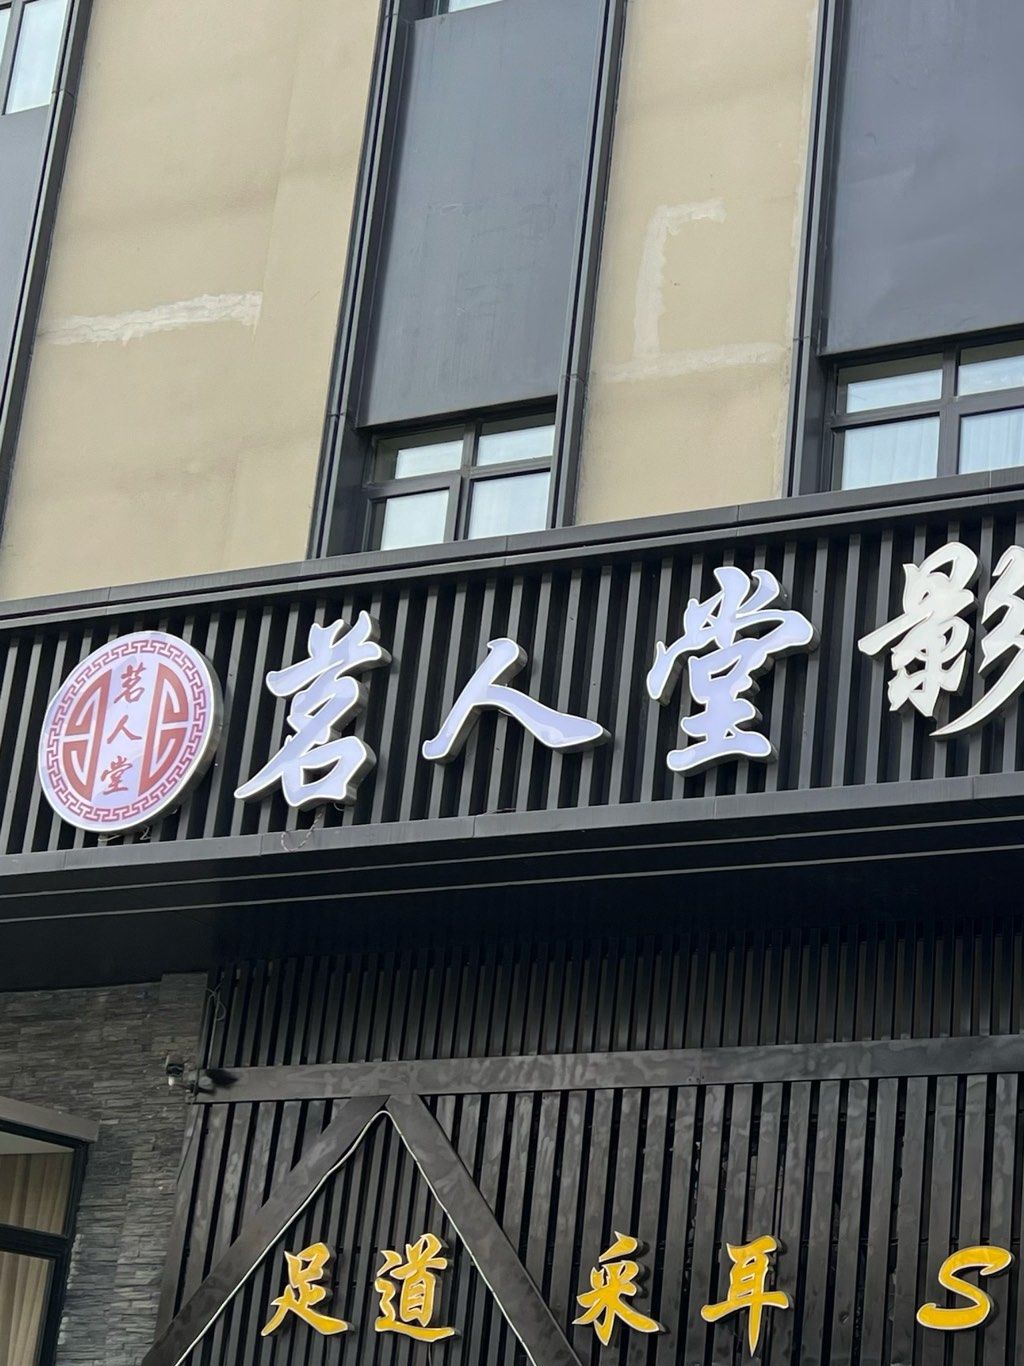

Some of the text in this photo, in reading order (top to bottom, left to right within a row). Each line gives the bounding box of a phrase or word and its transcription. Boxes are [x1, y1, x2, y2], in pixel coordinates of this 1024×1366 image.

[98, 664, 146, 797] 茗人堂
[261, 1232, 457, 1342] 足道
[576, 1230, 791, 1357] 采耳
